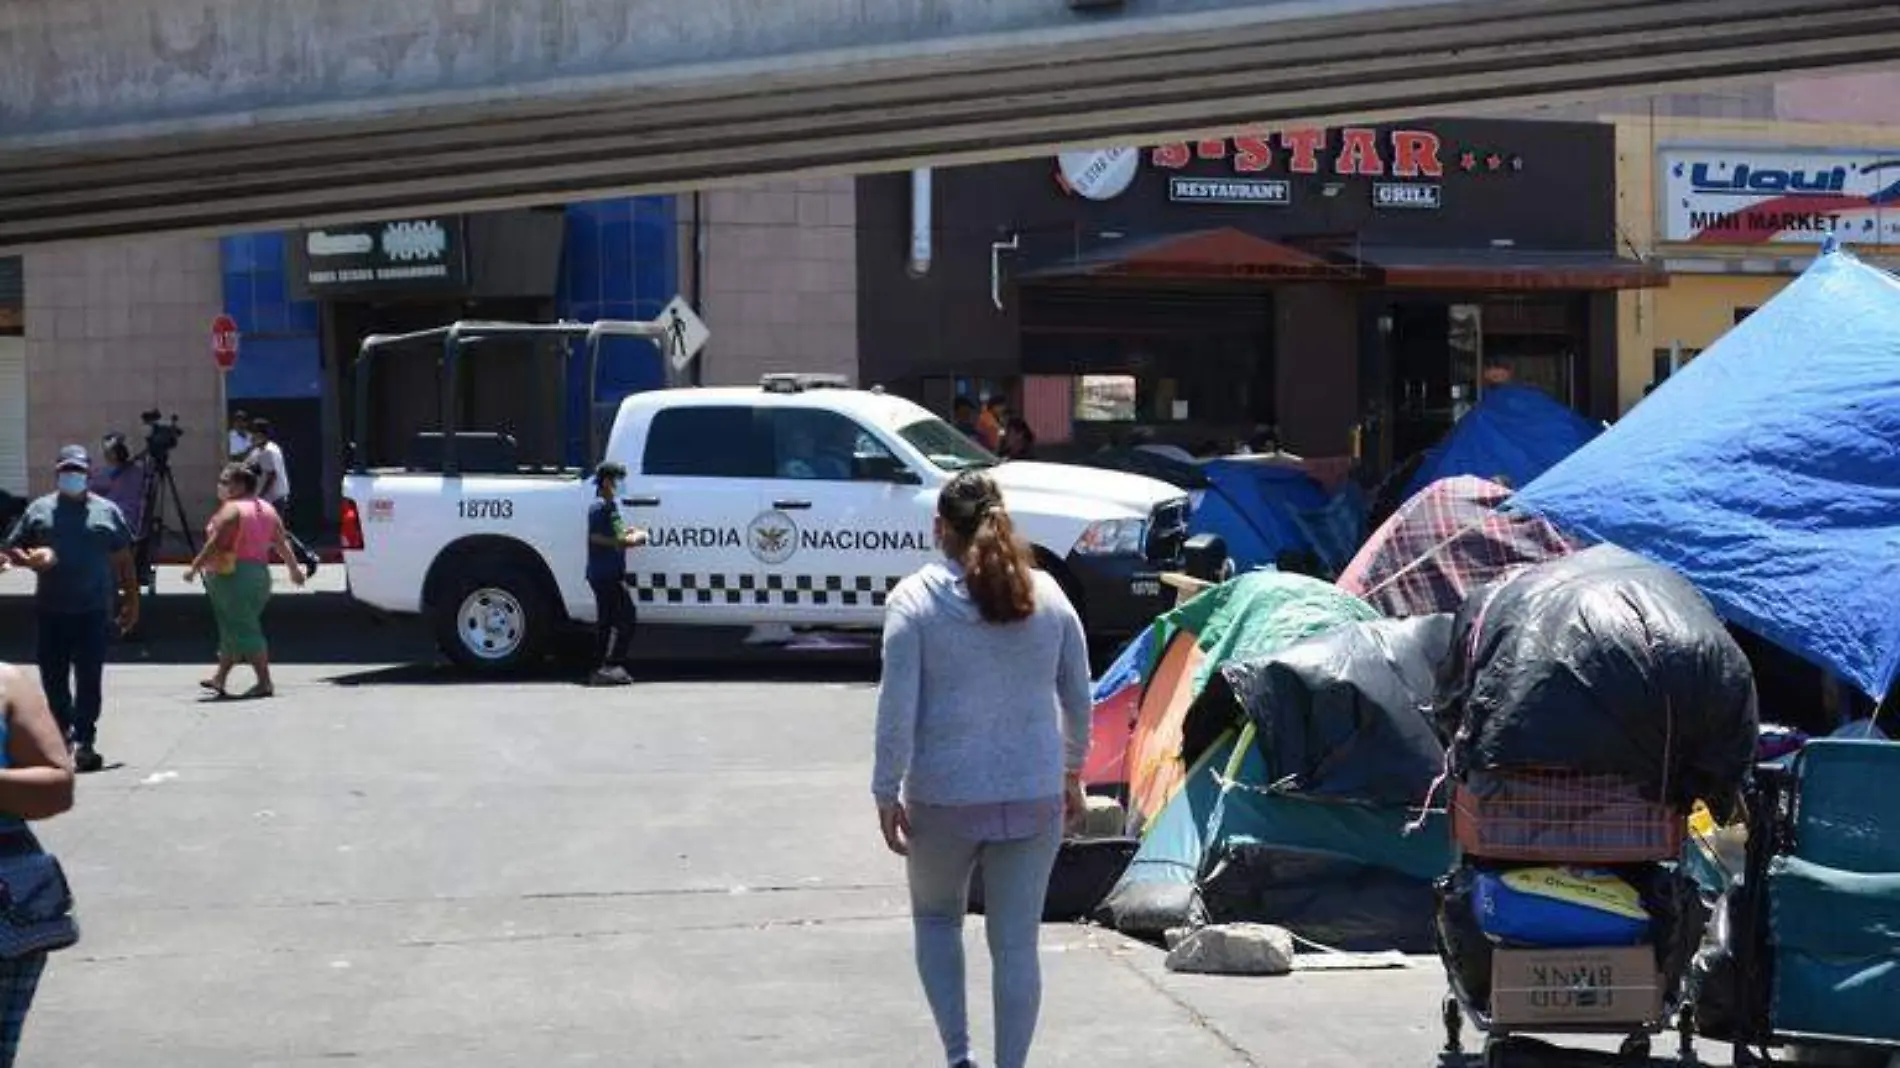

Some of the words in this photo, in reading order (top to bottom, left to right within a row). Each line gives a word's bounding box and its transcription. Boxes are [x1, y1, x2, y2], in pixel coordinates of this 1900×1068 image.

[1176, 182, 1284, 199] RESTAURANT
[1379, 187, 1435, 201] GRILL
[1689, 211, 1741, 230] MINI
[1747, 213, 1841, 232] MARKET
[458, 499, 513, 519] 18703
[642, 527, 741, 547] UARDIA
[801, 529, 930, 551] NACIONAL
